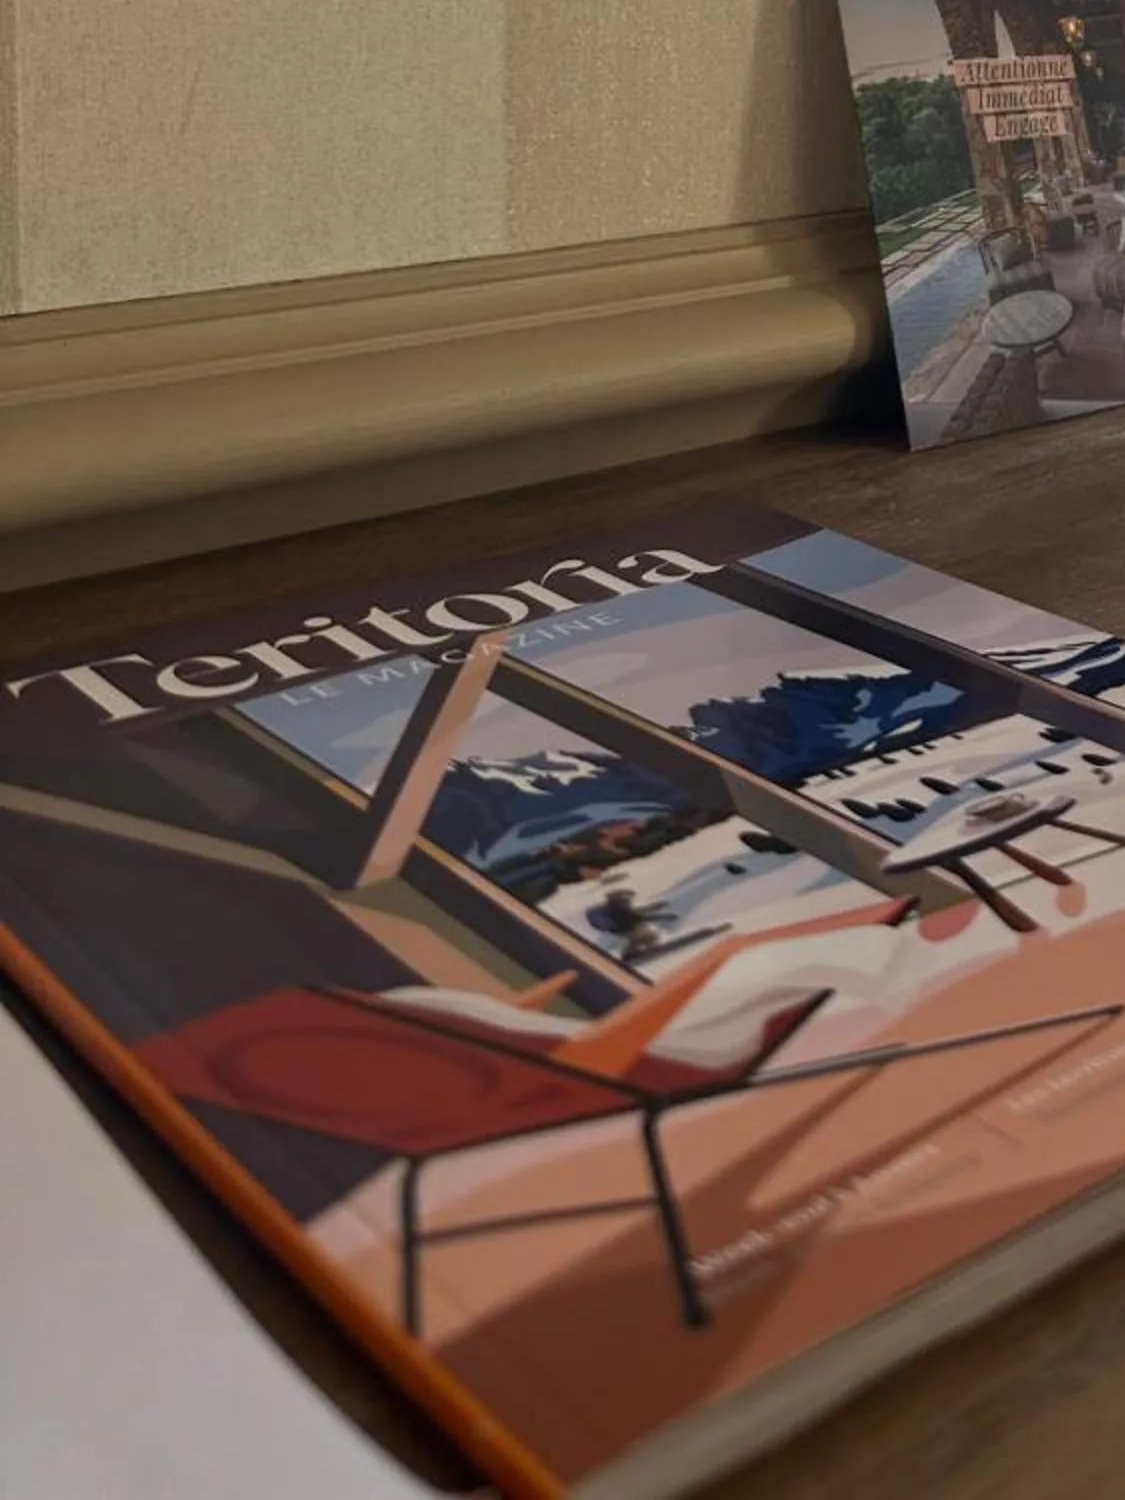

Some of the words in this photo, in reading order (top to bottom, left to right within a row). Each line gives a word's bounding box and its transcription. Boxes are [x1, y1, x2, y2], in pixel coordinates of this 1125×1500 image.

[5, 546, 728, 725] Teritoria
[277, 678, 341, 706] LE
[357, 610, 625, 687] MAGAZINE
